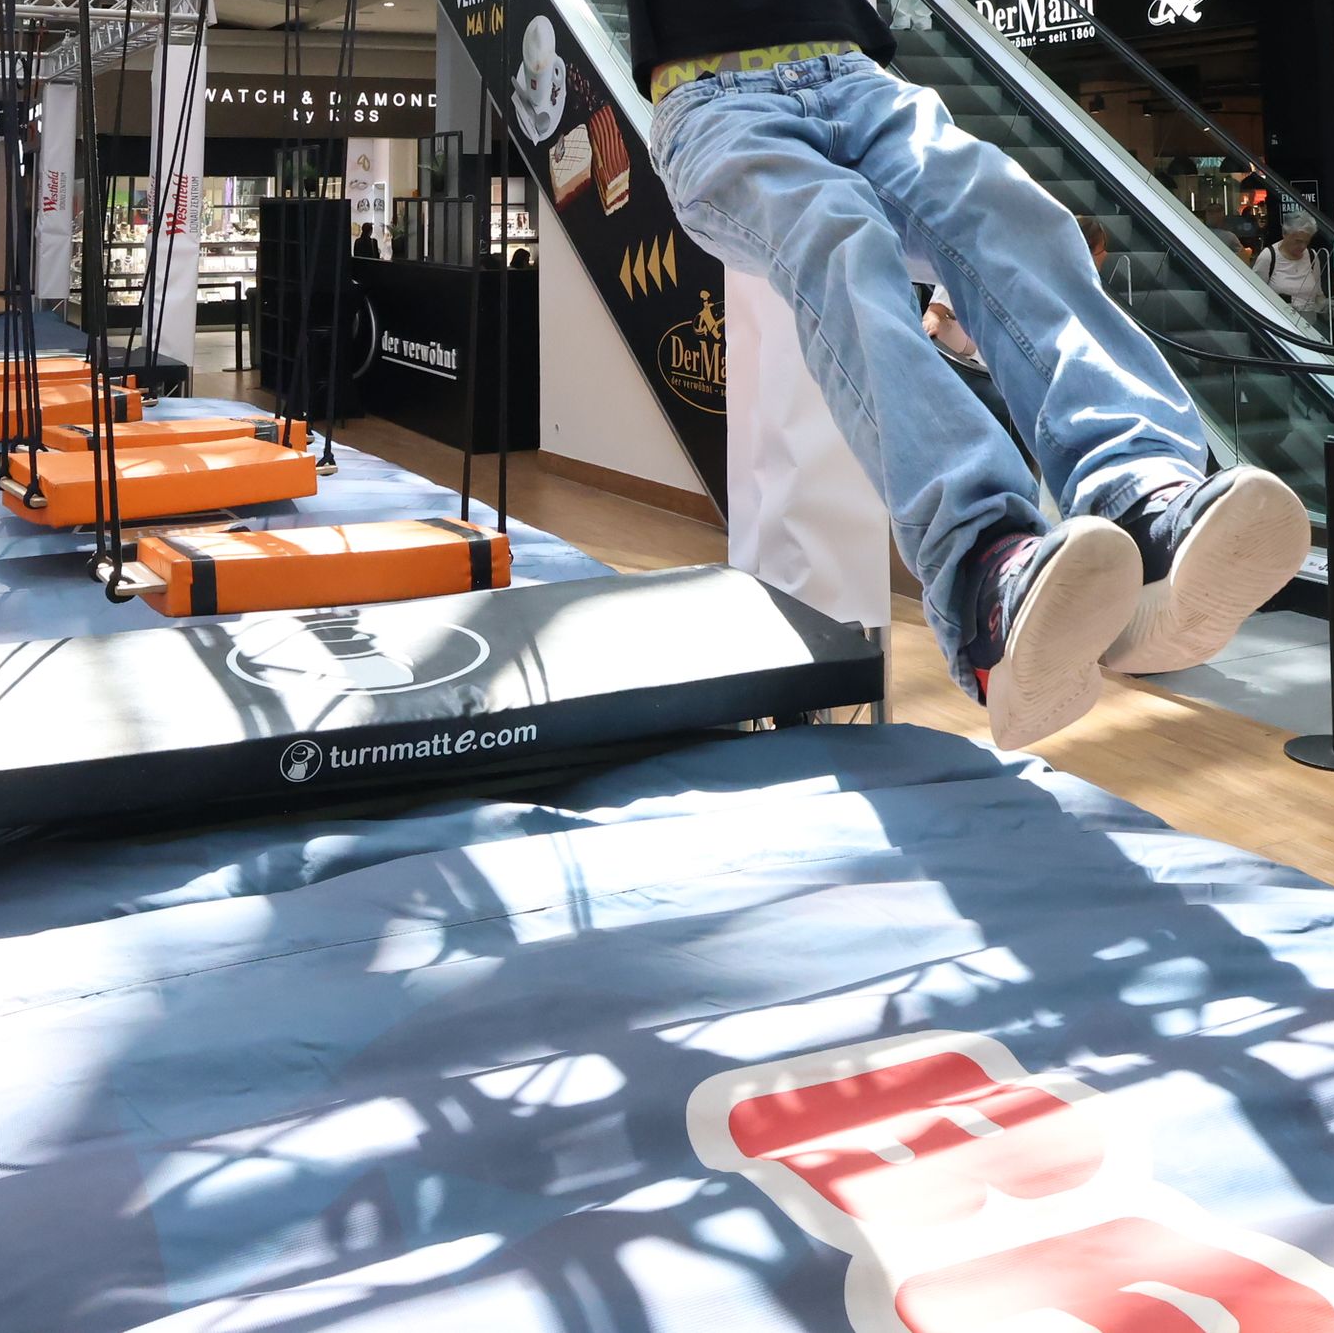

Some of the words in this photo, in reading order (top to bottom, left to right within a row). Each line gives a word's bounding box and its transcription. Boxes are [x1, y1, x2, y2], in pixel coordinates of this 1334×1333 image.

[1048, 30, 1068, 44] seit
[1071, 25, 1096, 40] 1860
[204, 88, 286, 104] WATCH
[301, 90, 314, 105] &
[329, 90, 437, 107] DAMOND
[43, 170, 60, 213] Westfield
[191, 176, 200, 212] ZENTRUM
[189, 212, 199, 234] DONAU
[382, 330, 399, 354] der
[402, 341, 457, 370] verwöhnt
[670, 376, 681, 387] der
[330, 724, 538, 769] turnmatte.com
